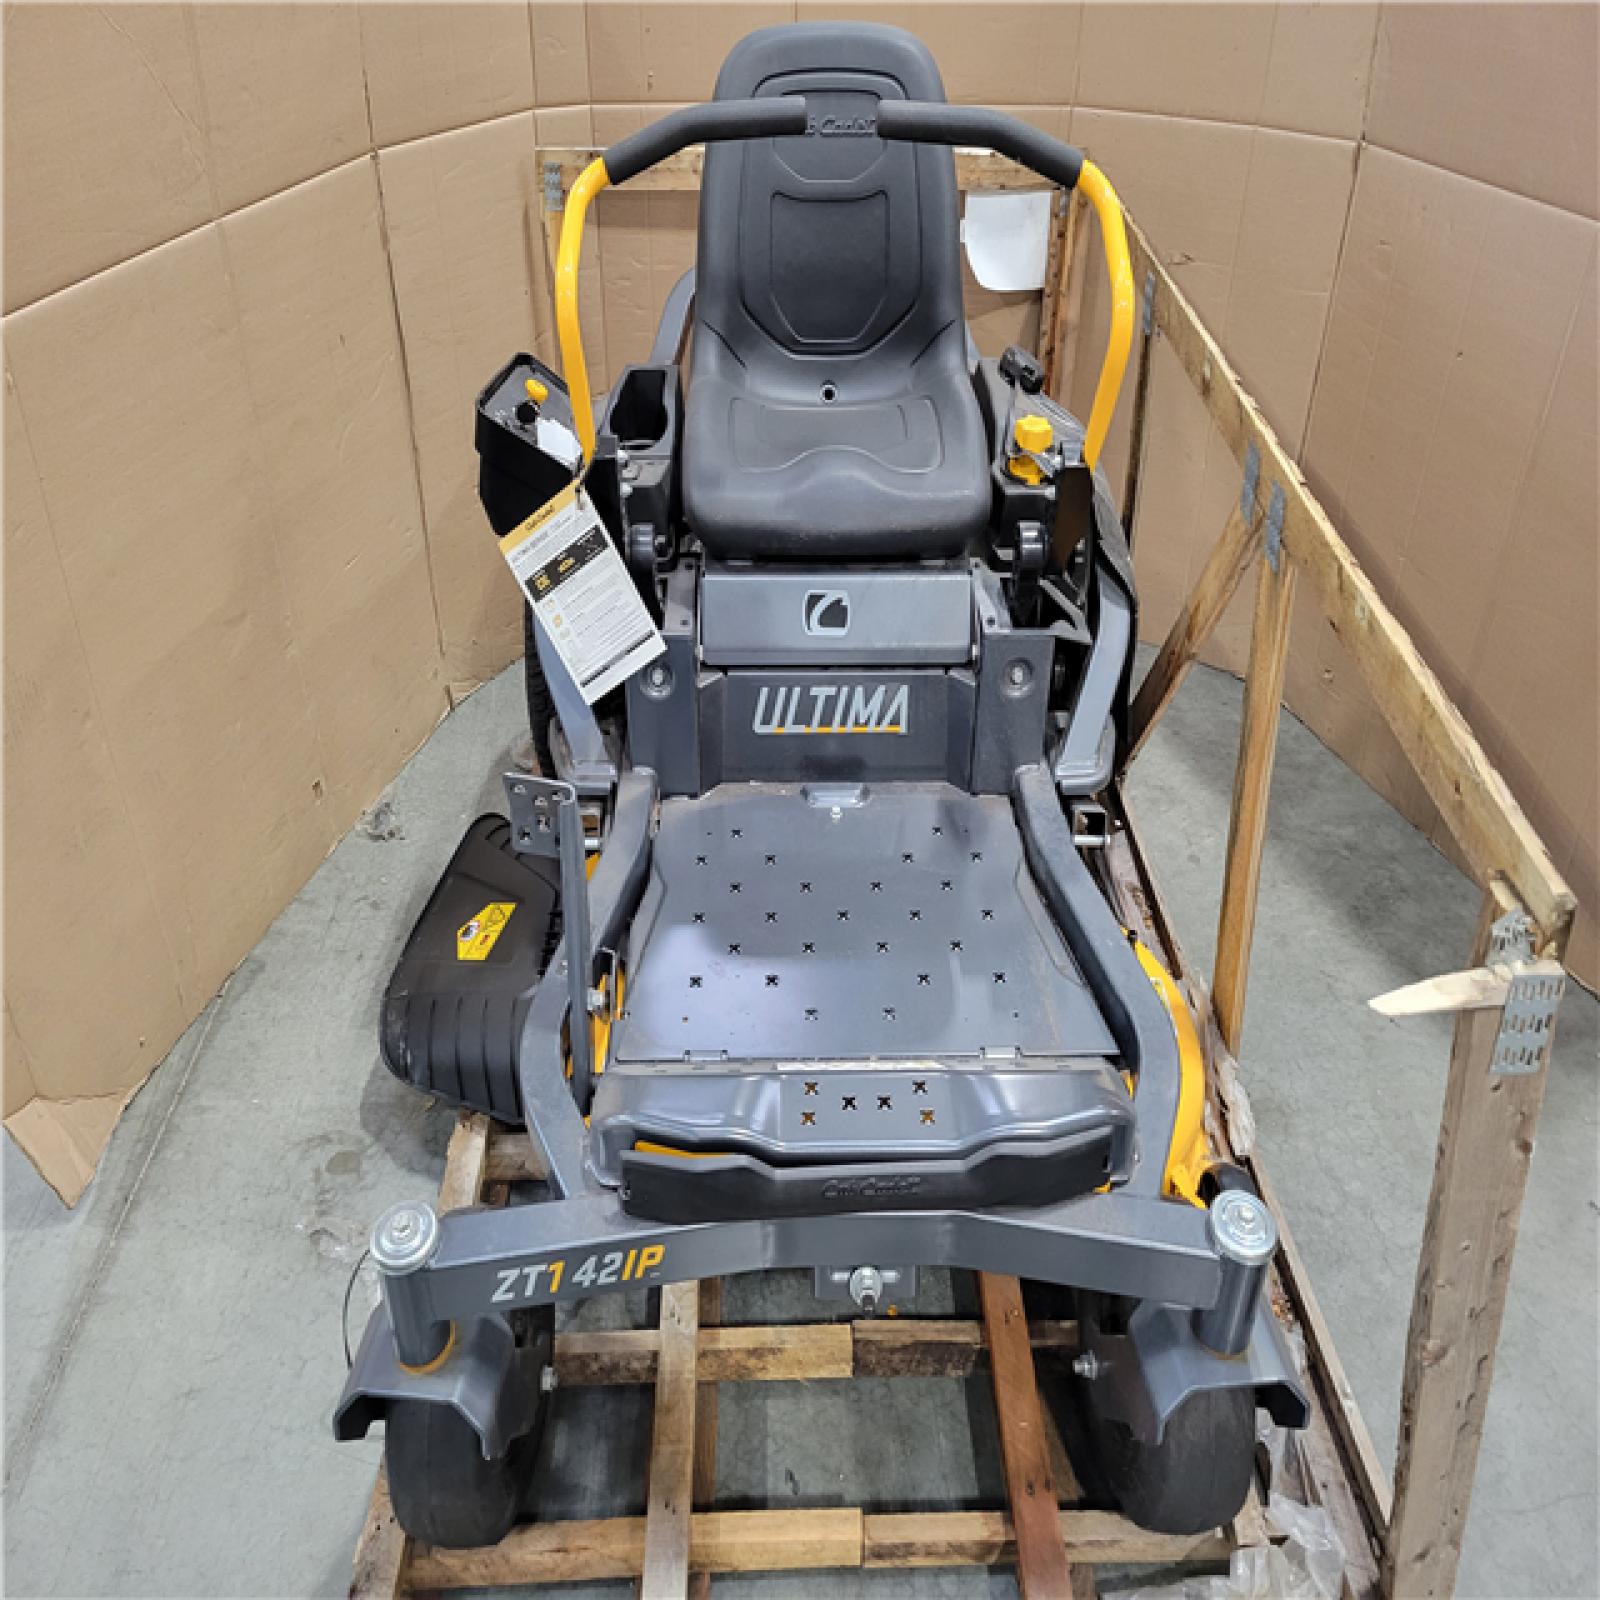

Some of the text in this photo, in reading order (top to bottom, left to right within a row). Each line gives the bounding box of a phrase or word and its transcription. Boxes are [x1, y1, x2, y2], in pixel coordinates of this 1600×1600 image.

[753, 684, 909, 735] ULTIMA
[491, 1244, 666, 1303] ZT1 42IP
